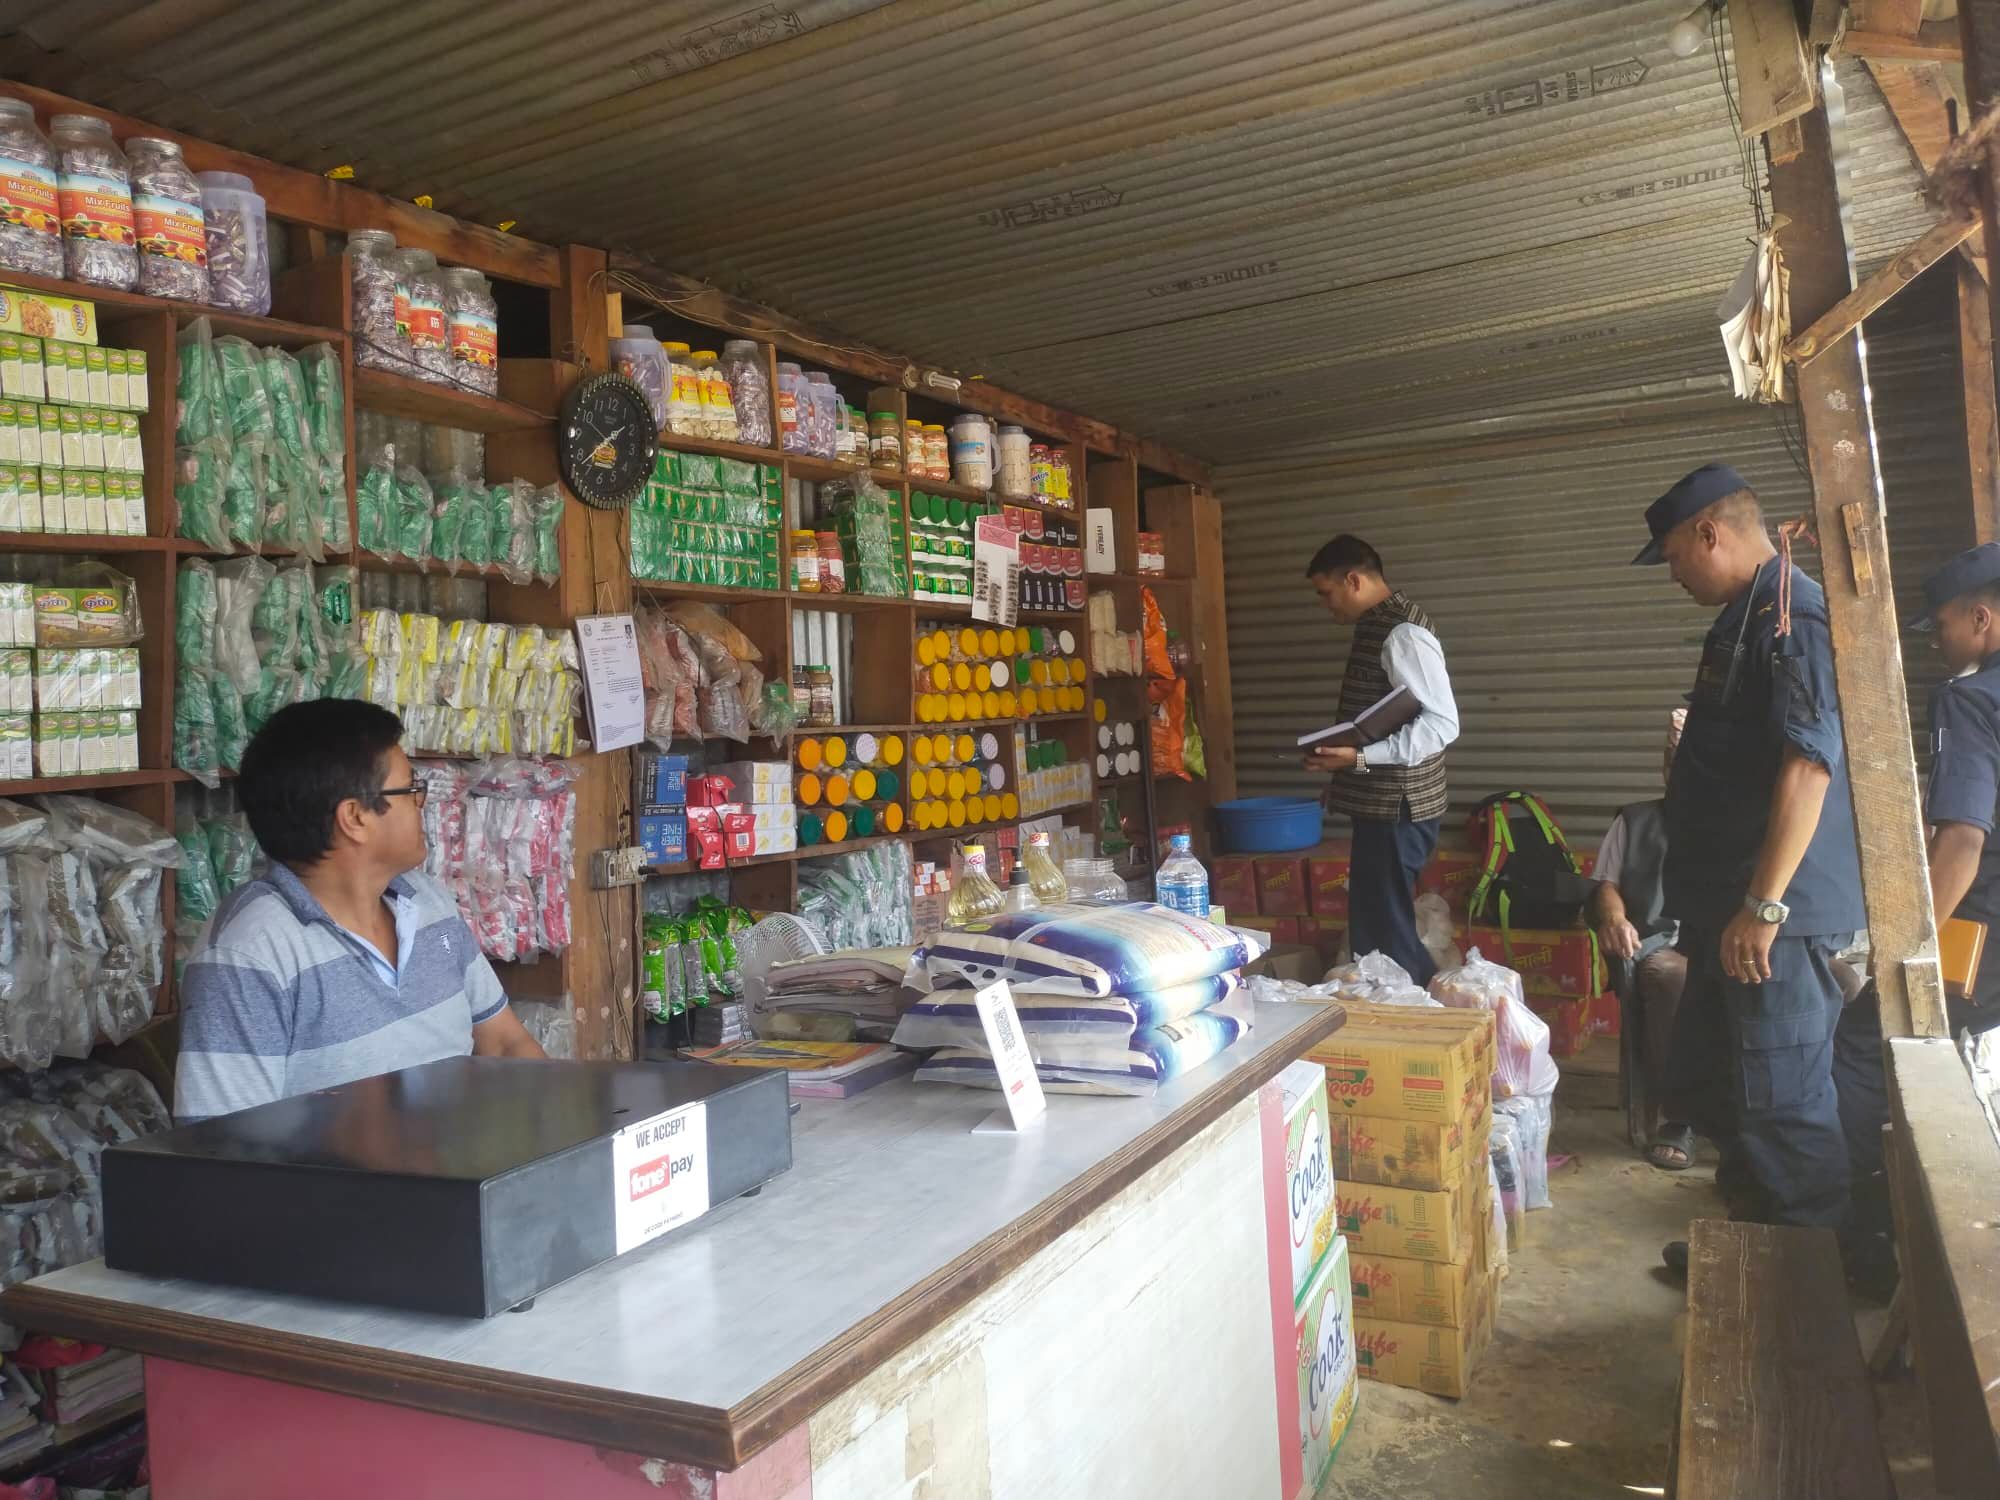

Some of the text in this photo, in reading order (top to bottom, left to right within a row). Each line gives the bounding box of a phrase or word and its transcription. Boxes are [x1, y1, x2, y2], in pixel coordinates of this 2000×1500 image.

[7, 180, 54, 200] Mix Fruits
[85, 196, 130, 212] Mix Fruits
[164, 217, 181, 228] Mix
[607, 397, 619, 412] 12
[582, 408, 594, 424] 10
[575, 427, 583, 442] 9
[628, 423, 637, 438] 2
[576, 447, 584, 461] 8
[628, 443, 636, 456] 3
[595, 471, 604, 485] 6
[662, 823, 683, 835] FINE
[661, 835, 683, 846] SUPER
[635, 1116, 687, 1149] WE ACCEPT
[670, 1153, 695, 1179] pay
[1292, 1134, 1325, 1220] Cook
[1309, 1311, 1345, 1412] Cook
